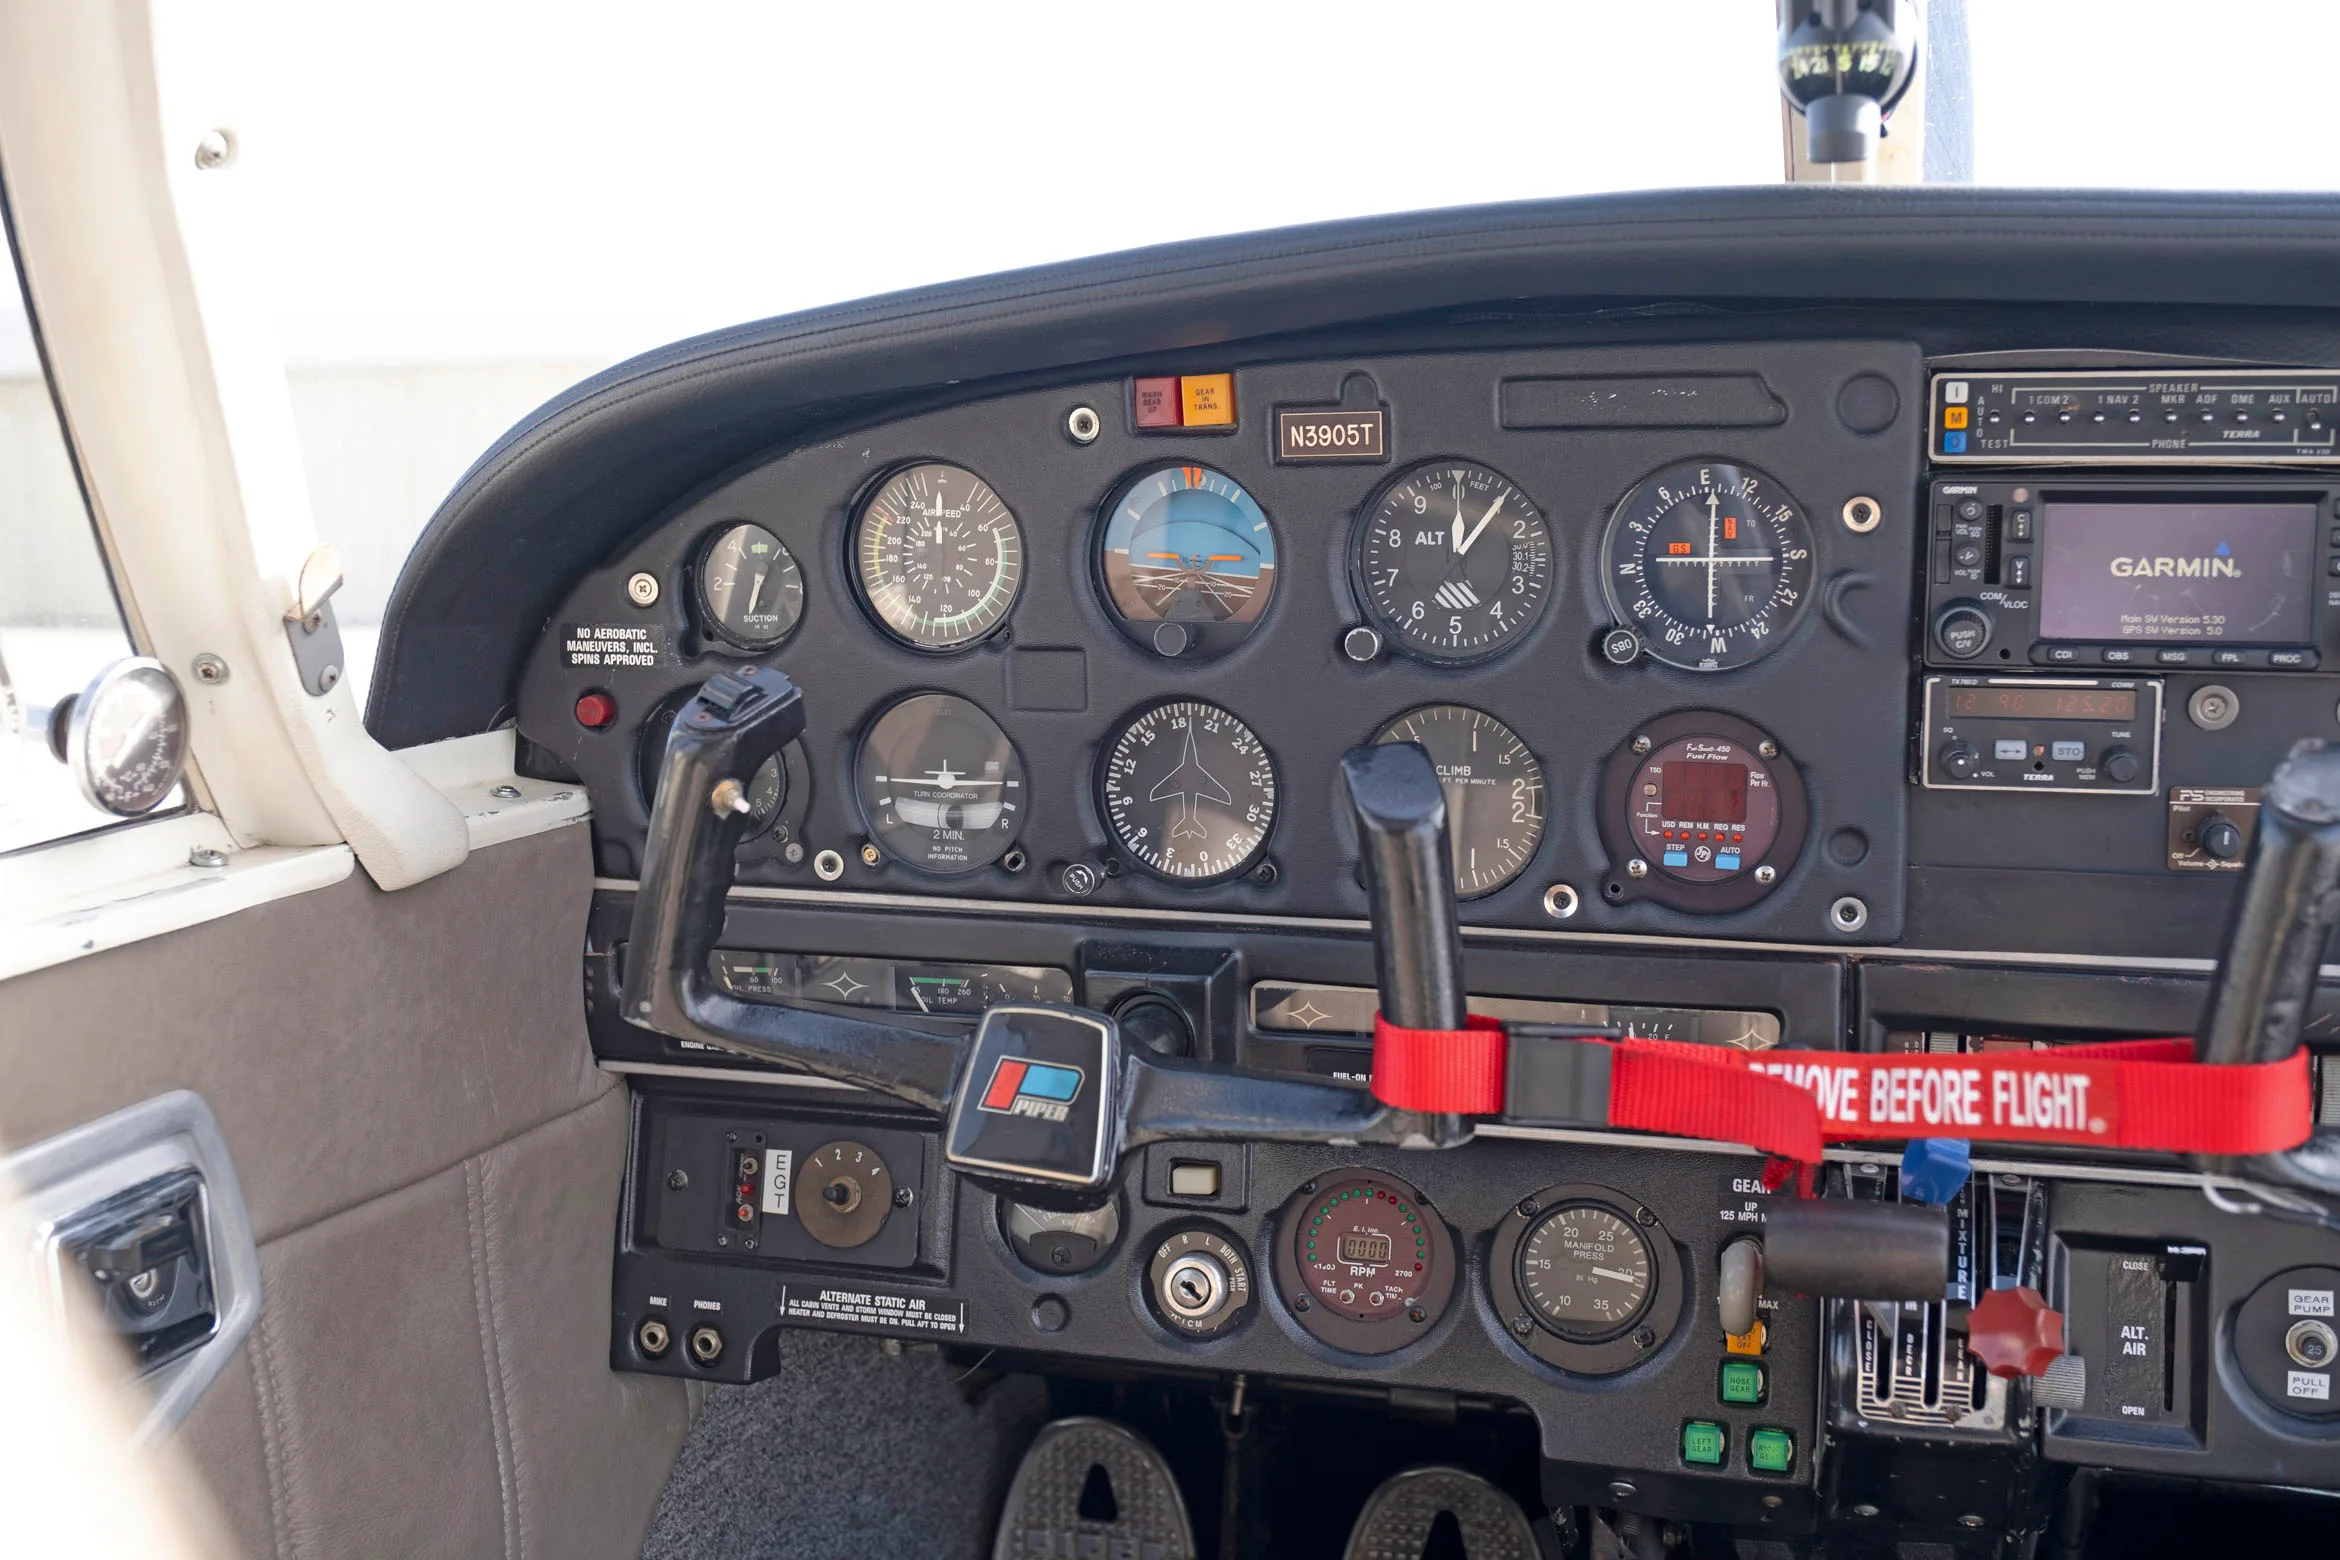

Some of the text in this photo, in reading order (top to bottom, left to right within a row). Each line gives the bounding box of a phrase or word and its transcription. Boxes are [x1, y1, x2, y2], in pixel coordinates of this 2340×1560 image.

[1195, 388, 1215, 396] GEAR
[1991, 385, 2003, 393] HI
[2149, 383, 2199, 393] SPEAKER
[2161, 394, 2186, 404] MKR
[2196, 394, 2218, 404] ADF
[2231, 394, 2255, 403] DME
[2268, 394, 2291, 403] AUX
[2301, 394, 2331, 403] AUTO
[1194, 402, 1218, 410] TRANS
[1290, 423, 1373, 448] N3905T
[2222, 430, 2260, 439] TERRA
[1980, 440, 2009, 449] TEST
[2151, 439, 2186, 448] PHONE
[1469, 480, 1489, 492] FEET
[1741, 477, 1758, 494] 12
[1942, 486, 1978, 494] GARMIN
[910, 502, 925, 510] 240
[959, 504, 970, 512] 40
[1774, 504, 1793, 522] 15
[896, 516, 910, 525] 220
[977, 524, 988, 532] 60
[887, 537, 902, 545] 200
[1415, 531, 1445, 545] ALT
[886, 555, 898, 563] 180
[985, 558, 995, 566] 80
[2110, 557, 2235, 578] GARMIN
[892, 575, 905, 583] 160
[968, 589, 980, 597] 100
[1780, 588, 1798, 606] 21
[908, 595, 921, 604] 140
[940, 604, 952, 612] 120
[1633, 600, 1652, 618] 33
[2120, 614, 2142, 623] Main
[2160, 615, 2200, 624] Version
[2203, 615, 2225, 625] 5.30
[577, 628, 647, 640] NO AEROBATIC
[1751, 621, 1769, 639] 24
[1950, 630, 1975, 639] PUSH
[2122, 626, 2143, 635] GPS
[2161, 626, 2200, 635] Version
[2207, 627, 2223, 635] 5.0
[1665, 628, 1685, 645] 30
[566, 640, 658, 654] MANEUVERS, INCL.
[1611, 639, 1632, 654] OBS
[571, 653, 654, 666] SPINS APPROVED
[2055, 651, 2072, 659] CDI
[2107, 652, 2129, 660] OBS
[2162, 652, 2185, 661] MSG
[2222, 653, 2239, 662] FPL
[2273, 654, 2301, 663] PROC
[1170, 718, 1187, 730] 18
[1203, 720, 1220, 734] 21
[1141, 732, 1156, 747] 15
[1231, 738, 1249, 755] 24
[2057, 747, 2081, 755] STO
[1124, 758, 1137, 775] 12
[1436, 765, 1471, 776] CLIMB
[1249, 770, 1262, 787] 27
[2023, 773, 2054, 781] TERRA
[1512, 778, 1525, 800] 2
[932, 791, 978, 800] COORDINATOR
[1246, 804, 1260, 822] 30
[1512, 801, 1525, 823] 2
[1679, 821, 1694, 829] REM
[1714, 823, 1728, 831] REQ
[933, 829, 965, 841] 2 MIN.
[1226, 833, 1243, 850] 33
[1069, 873, 1084, 890] PUSH
[1333, 1071, 1366, 1082] FUEL-ON
[1870, 1067, 1982, 1125] BEFORE
[1012, 1099, 1070, 1122] PIPER
[774, 1155, 787, 1208] EGT
[1744, 1202, 1757, 1212] UP
[1720, 1210, 1735, 1221] 125
[1738, 1211, 1758, 1222] MPH
[1563, 1227, 1579, 1237] 20
[1598, 1231, 1614, 1241] 25
[1158, 1244, 1172, 1259] OFF
[1564, 1240, 1615, 1252] MANIFOLD
[1219, 1244, 1238, 1265] BOTH
[1573, 1250, 1605, 1261] PRESS
[1957, 1208, 1968, 1300] MIXTURE
[1539, 1258, 1551, 1270] 15
[2123, 1261, 2149, 1271] CLOSE
[1350, 1266, 1376, 1278] RPM
[1234, 1268, 1247, 1293] START
[649, 1296, 667, 1307] MIKE
[819, 1290, 926, 1311] ALTERNATE STATIC AIR
[1559, 1295, 1571, 1306] 10
[1593, 1299, 1609, 1310] 35
[1758, 1299, 1779, 1310] MAX
[2294, 1295, 2329, 1304] GEAR
[693, 1300, 721, 1311] PHONES
[789, 1299, 956, 1322] ALL CABIN VENTS AND STORM WINDOW MUST BE CLOSED
[2294, 1304, 2330, 1313] PUMP
[788, 1307, 810, 1317] HEATER
[812, 1310, 825, 1318] AND
[826, 1311, 859, 1321] DEFROSTER
[861, 1315, 878, 1323] MUST
[880, 1316, 887, 1324] BE
[901, 1319, 916, 1327] PULL
[917, 1320, 929, 1328] AFT
[930, 1321, 938, 1329] TO
[940, 1323, 956, 1331] OPEN
[2121, 1326, 2149, 1341] ALT.
[2122, 1342, 2146, 1356] AIR
[1729, 1377, 1750, 1385] NOSE
[2292, 1377, 2326, 1387] PULL
[1729, 1384, 1750, 1393] GEAR
[2292, 1386, 2319, 1395] OFF
[2122, 1406, 2145, 1416] OPEN
[1692, 1437, 1712, 1445] LEFT
